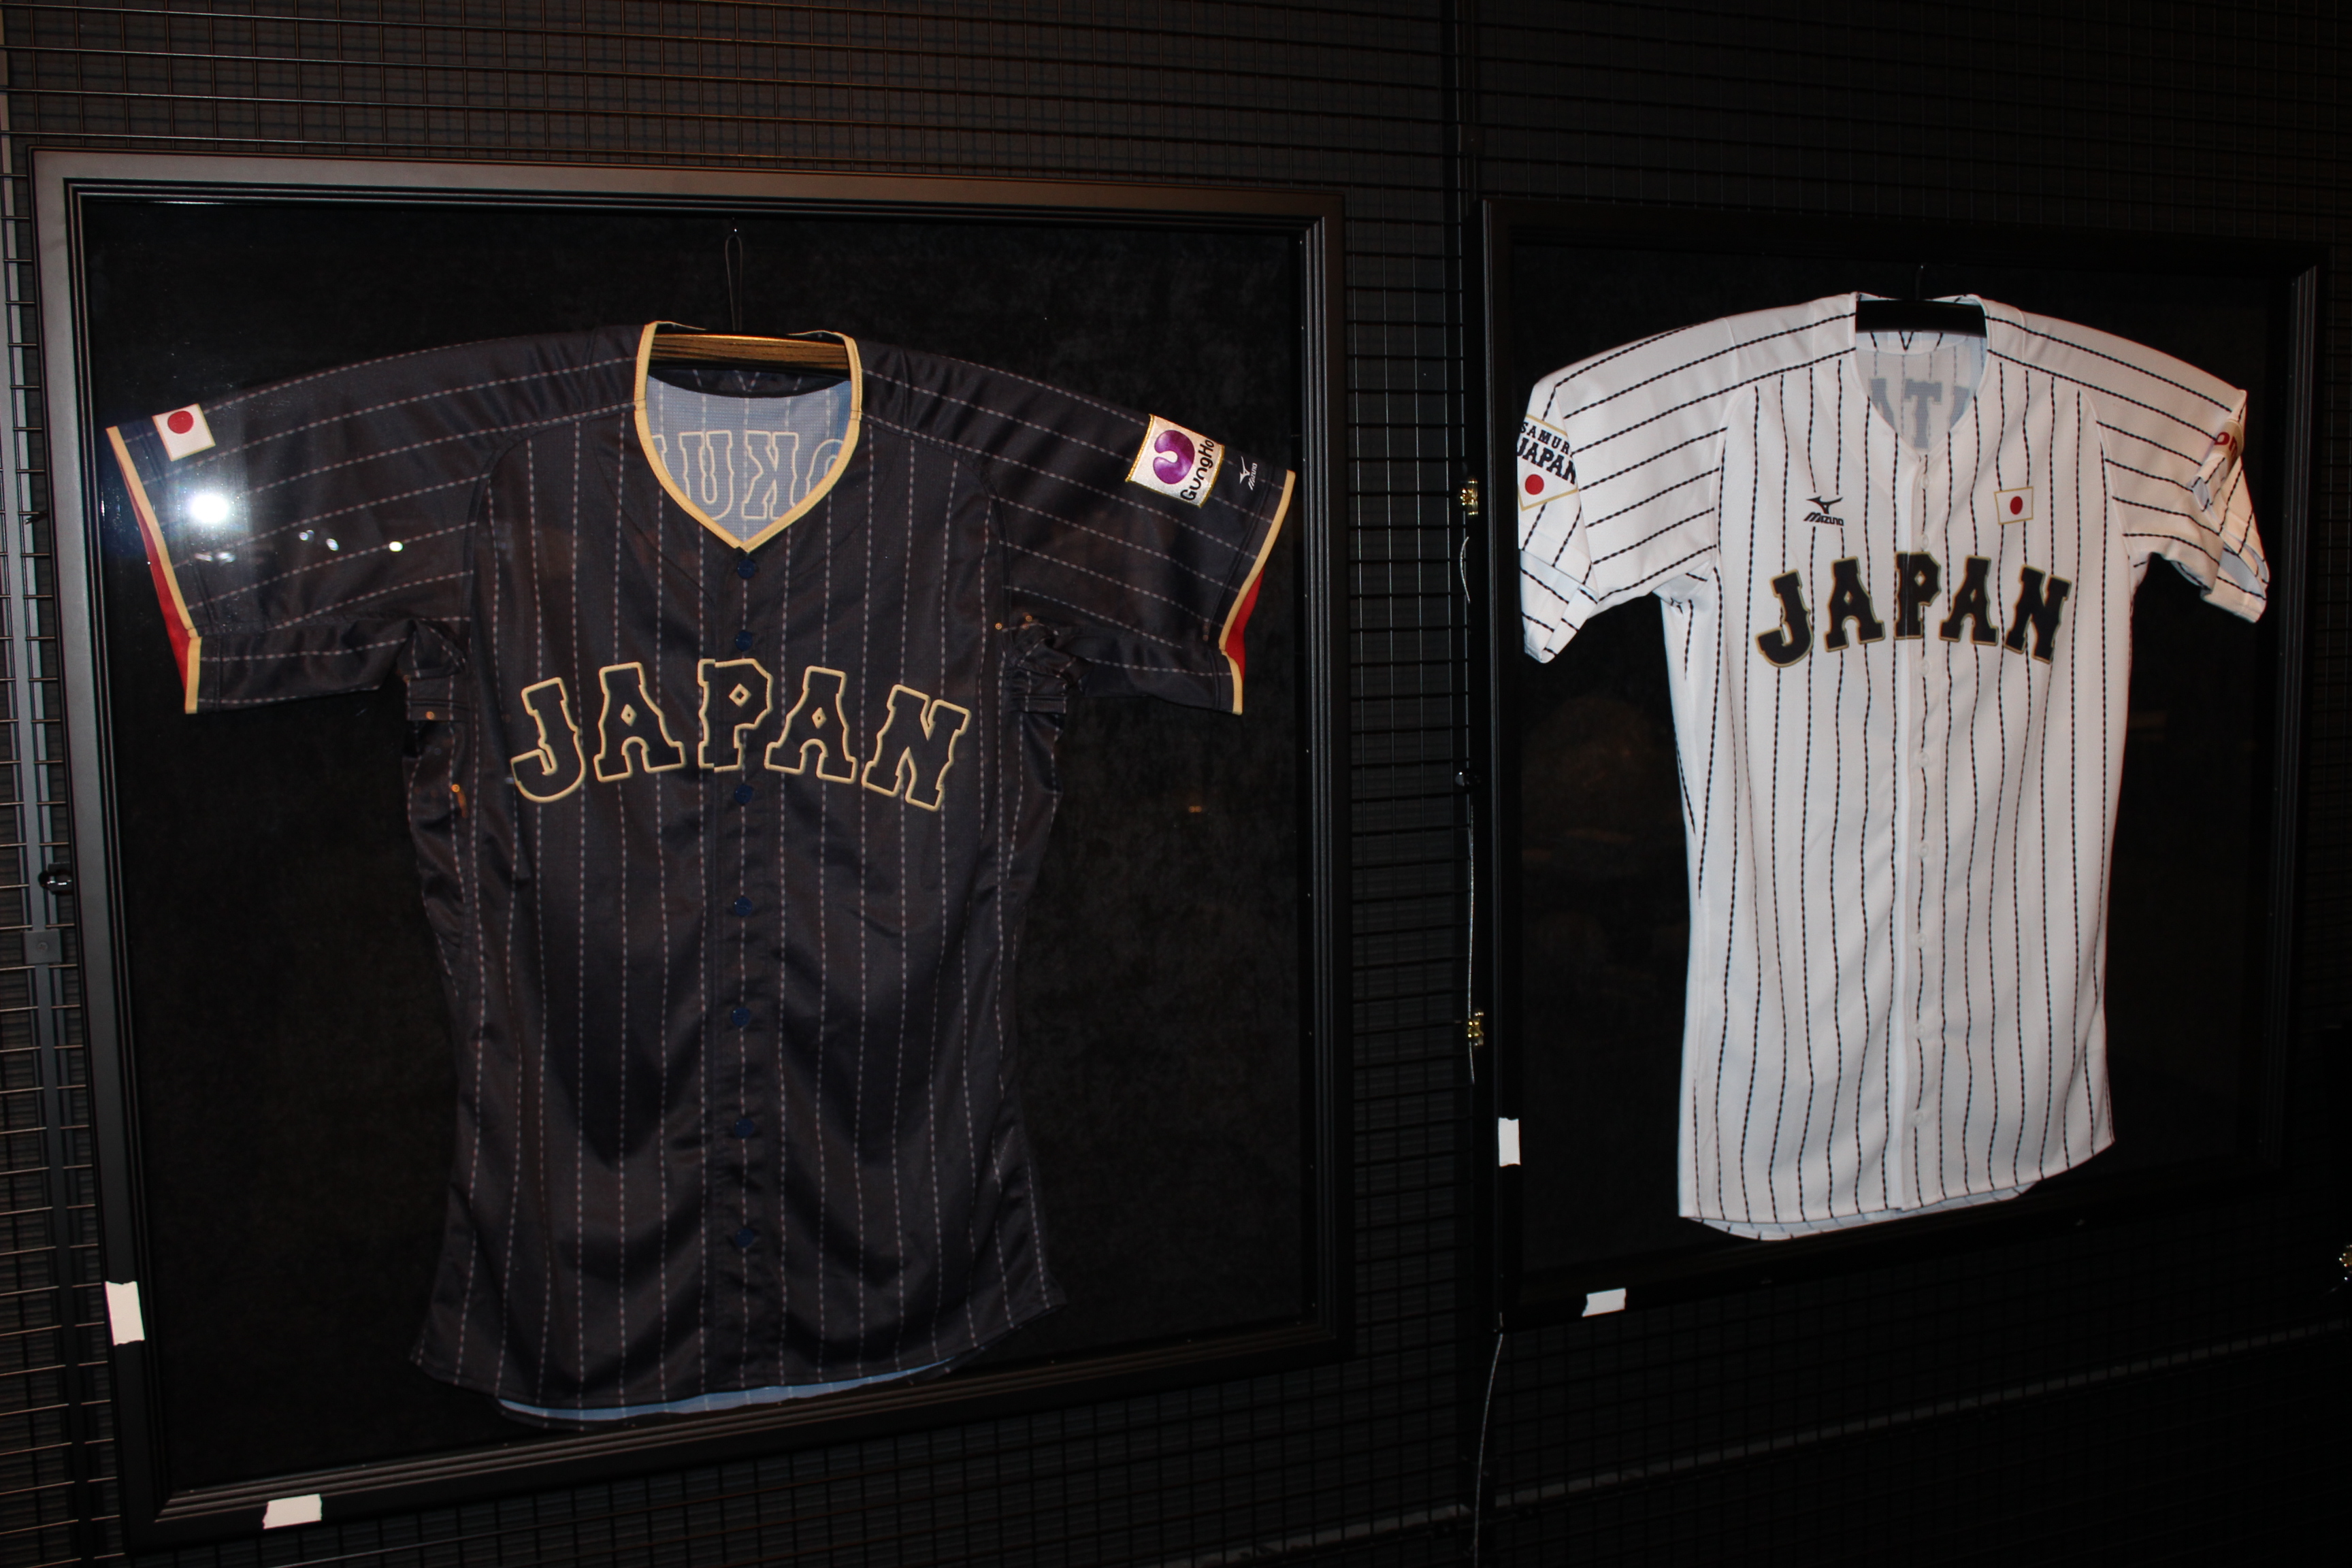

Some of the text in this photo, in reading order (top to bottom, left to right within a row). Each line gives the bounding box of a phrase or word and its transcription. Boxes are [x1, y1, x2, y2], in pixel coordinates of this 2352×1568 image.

[1180, 439, 1215, 502] GungHo
[1520, 421, 1571, 455] SAMUR
[1755, 551, 2072, 667] JAPAN
[511, 658, 970, 811] JAPAN
